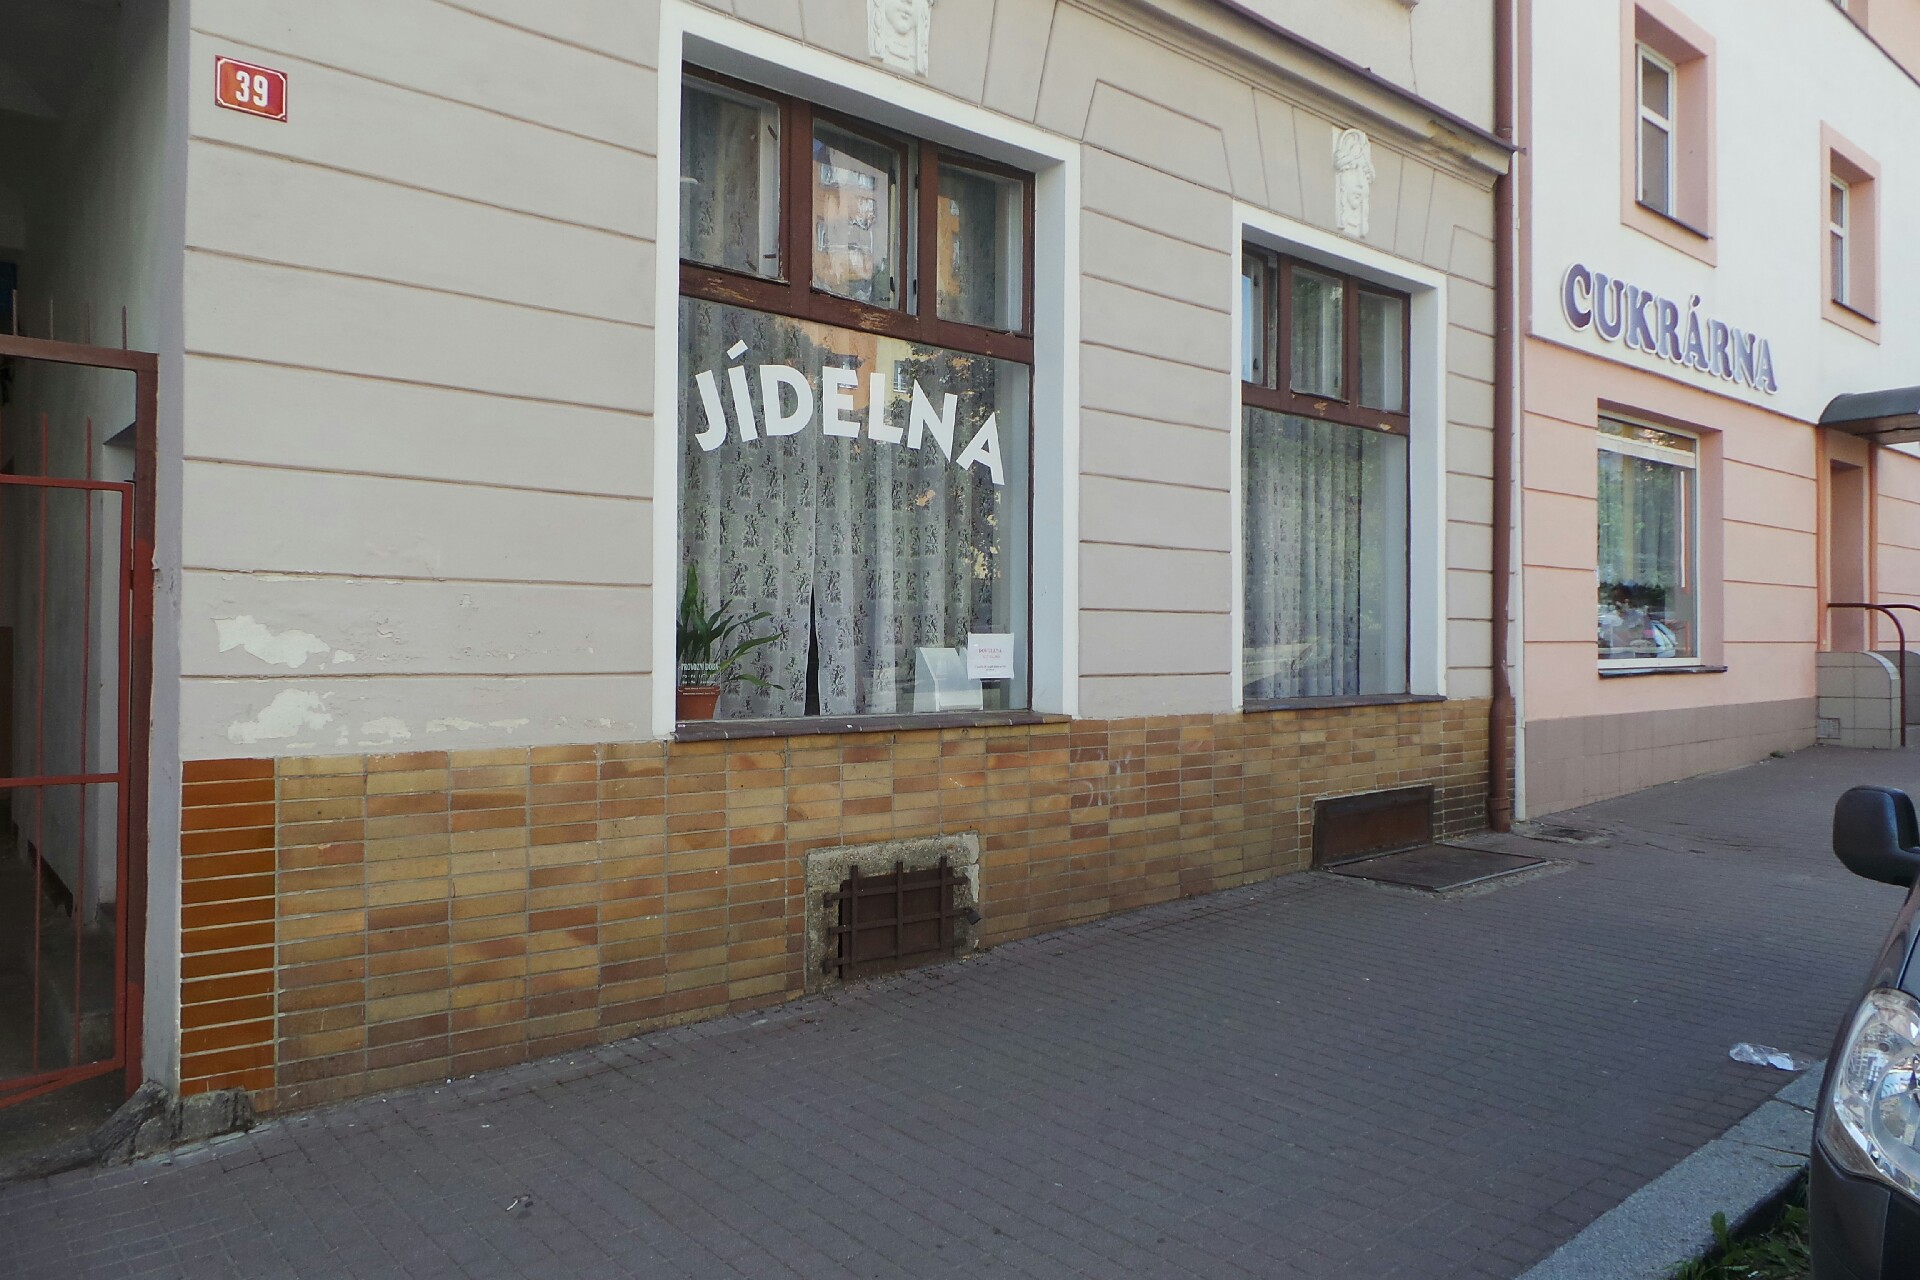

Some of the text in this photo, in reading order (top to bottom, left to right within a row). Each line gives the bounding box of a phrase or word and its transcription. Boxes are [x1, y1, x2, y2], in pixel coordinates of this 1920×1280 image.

[235, 70, 269, 107] 39
[1561, 263, 1778, 395] CUKRÁRNA
[695, 339, 1005, 486] JÍDELNA
